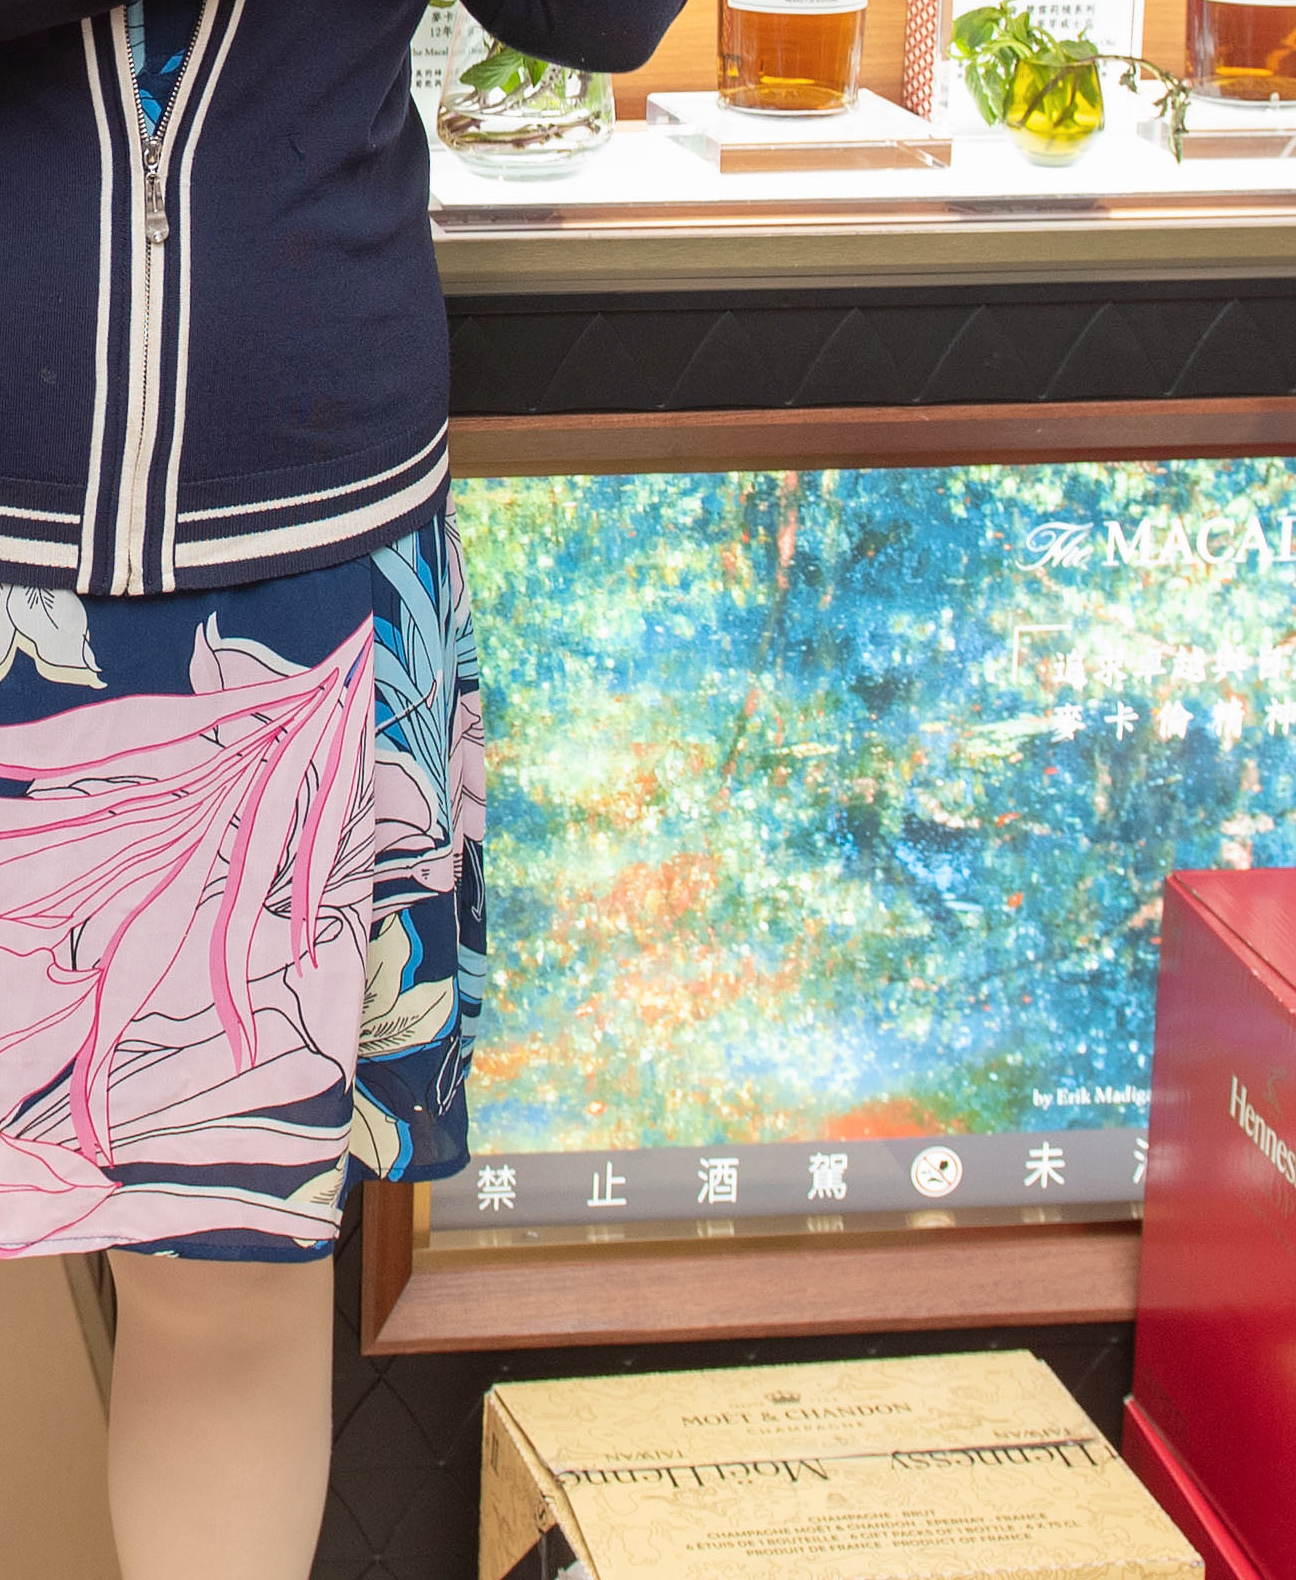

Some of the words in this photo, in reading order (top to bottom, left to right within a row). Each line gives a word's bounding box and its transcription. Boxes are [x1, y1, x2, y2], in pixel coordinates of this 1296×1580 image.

[1015, 521, 1095, 571] The
[1033, 1087, 1054, 1111] by
[1056, 1085, 1091, 1106] Erik
[477, 1151, 849, 1213] 禁止酒駕
[761, 1411, 779, 1423] &
[785, 1401, 912, 1421] CHANDON
[746, 1421, 863, 1435] CHAMPAGNE
[993, 1427, 1071, 1439] TAIWAN
[605, 1449, 684, 1463] TAIWAN
[706, 1527, 790, 1539] CHAMPAGNE
[847, 1520, 915, 1530] CHANDON
[995, 1512, 1047, 1522] FRANCE
[902, 1509, 934, 1518] BRUT
[737, 1540, 753, 1548] DE
[766, 1534, 837, 1545] BOUTEILLE
[860, 1531, 887, 1540] GIFT
[892, 1529, 933, 1538] PACKS
[936, 1528, 952, 1536] OF
[965, 1524, 1014, 1533] BOTTLE
[746, 1546, 804, 1556] PRODUIT
[808, 1544, 826, 1552] DE
[829, 1541, 879, 1551] FRANCE
[892, 1537, 954, 1547] PRODUCT
[959, 1536, 976, 1544] OF
[980, 1532, 1031, 1541] FRANCE
